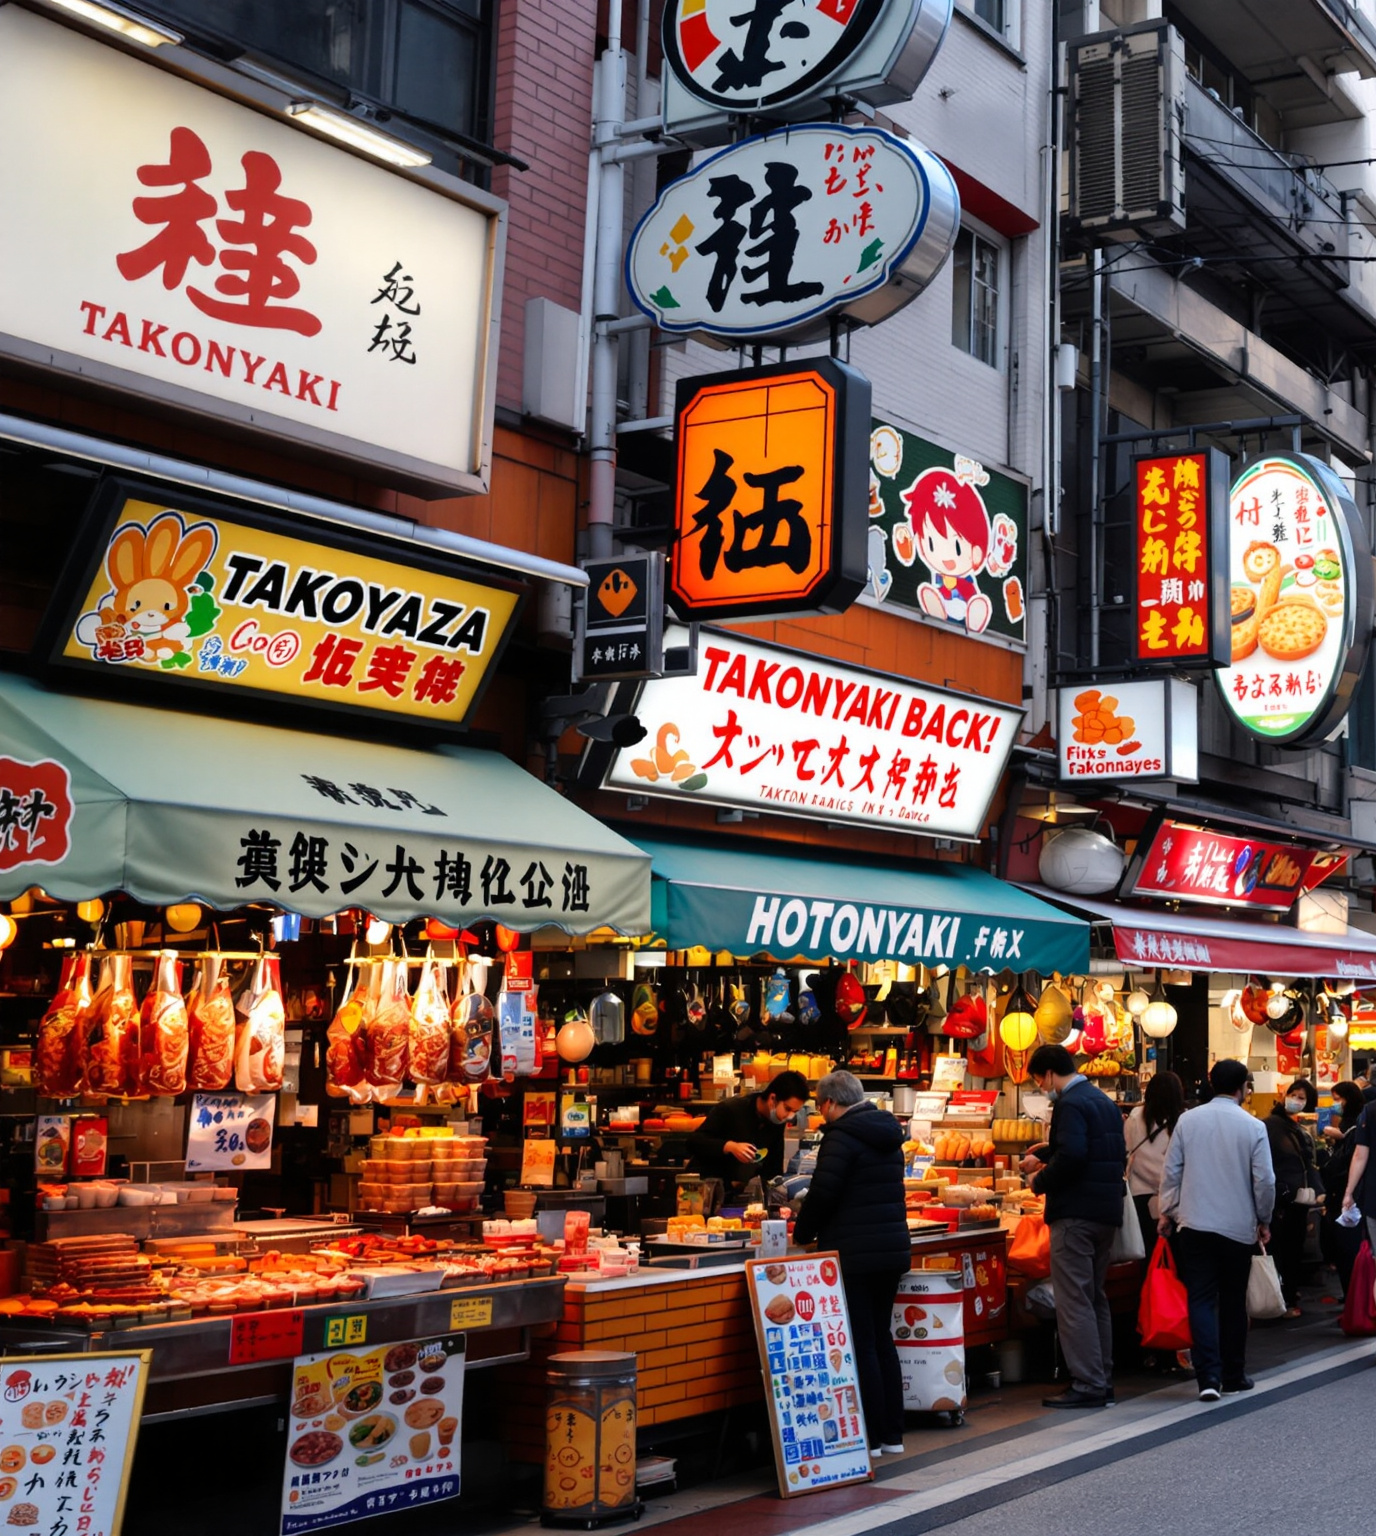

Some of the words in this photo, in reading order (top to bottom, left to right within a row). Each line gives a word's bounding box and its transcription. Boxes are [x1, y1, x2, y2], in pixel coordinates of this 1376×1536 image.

[80, 301, 342, 412] TAKONYAKI
[221, 555, 490, 652] TAKOYAZA
[703, 646, 902, 731] TAKONYAKI
[901, 697, 1001, 754] BACK!
[746, 896, 961, 959] HOTONYAKI
